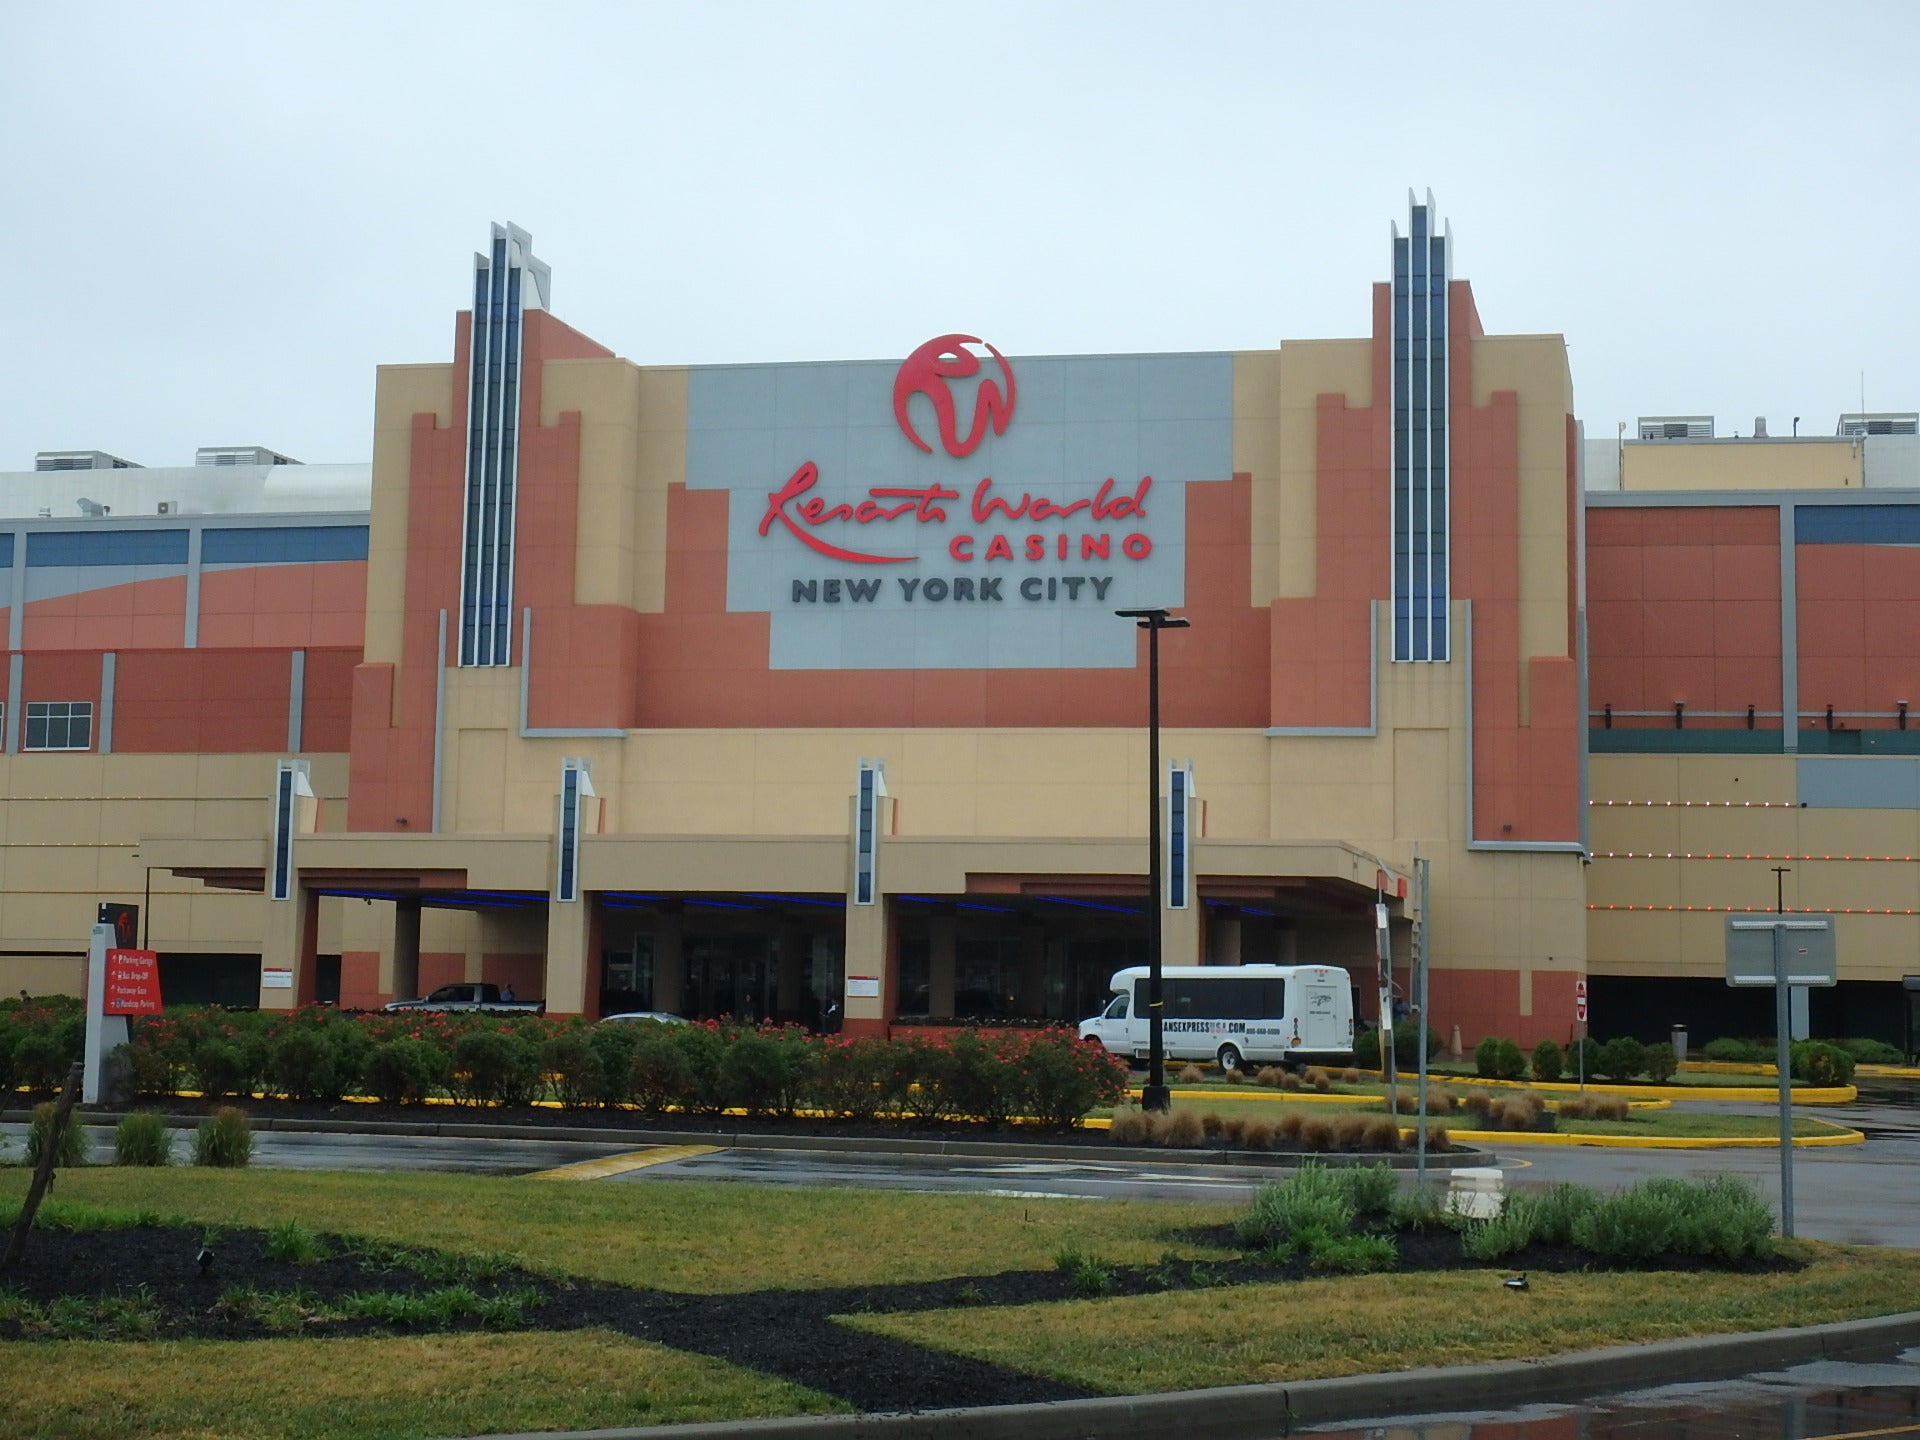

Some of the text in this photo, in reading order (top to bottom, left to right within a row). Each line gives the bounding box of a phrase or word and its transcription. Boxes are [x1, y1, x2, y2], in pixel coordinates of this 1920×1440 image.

[758, 461, 1152, 564] Resorts World
[949, 533, 1152, 561] CASINO
[791, 576, 1113, 604] NEW YORK CITY
[1163, 1021, 1246, 1034] ANSEXPRESSUSA.COM
